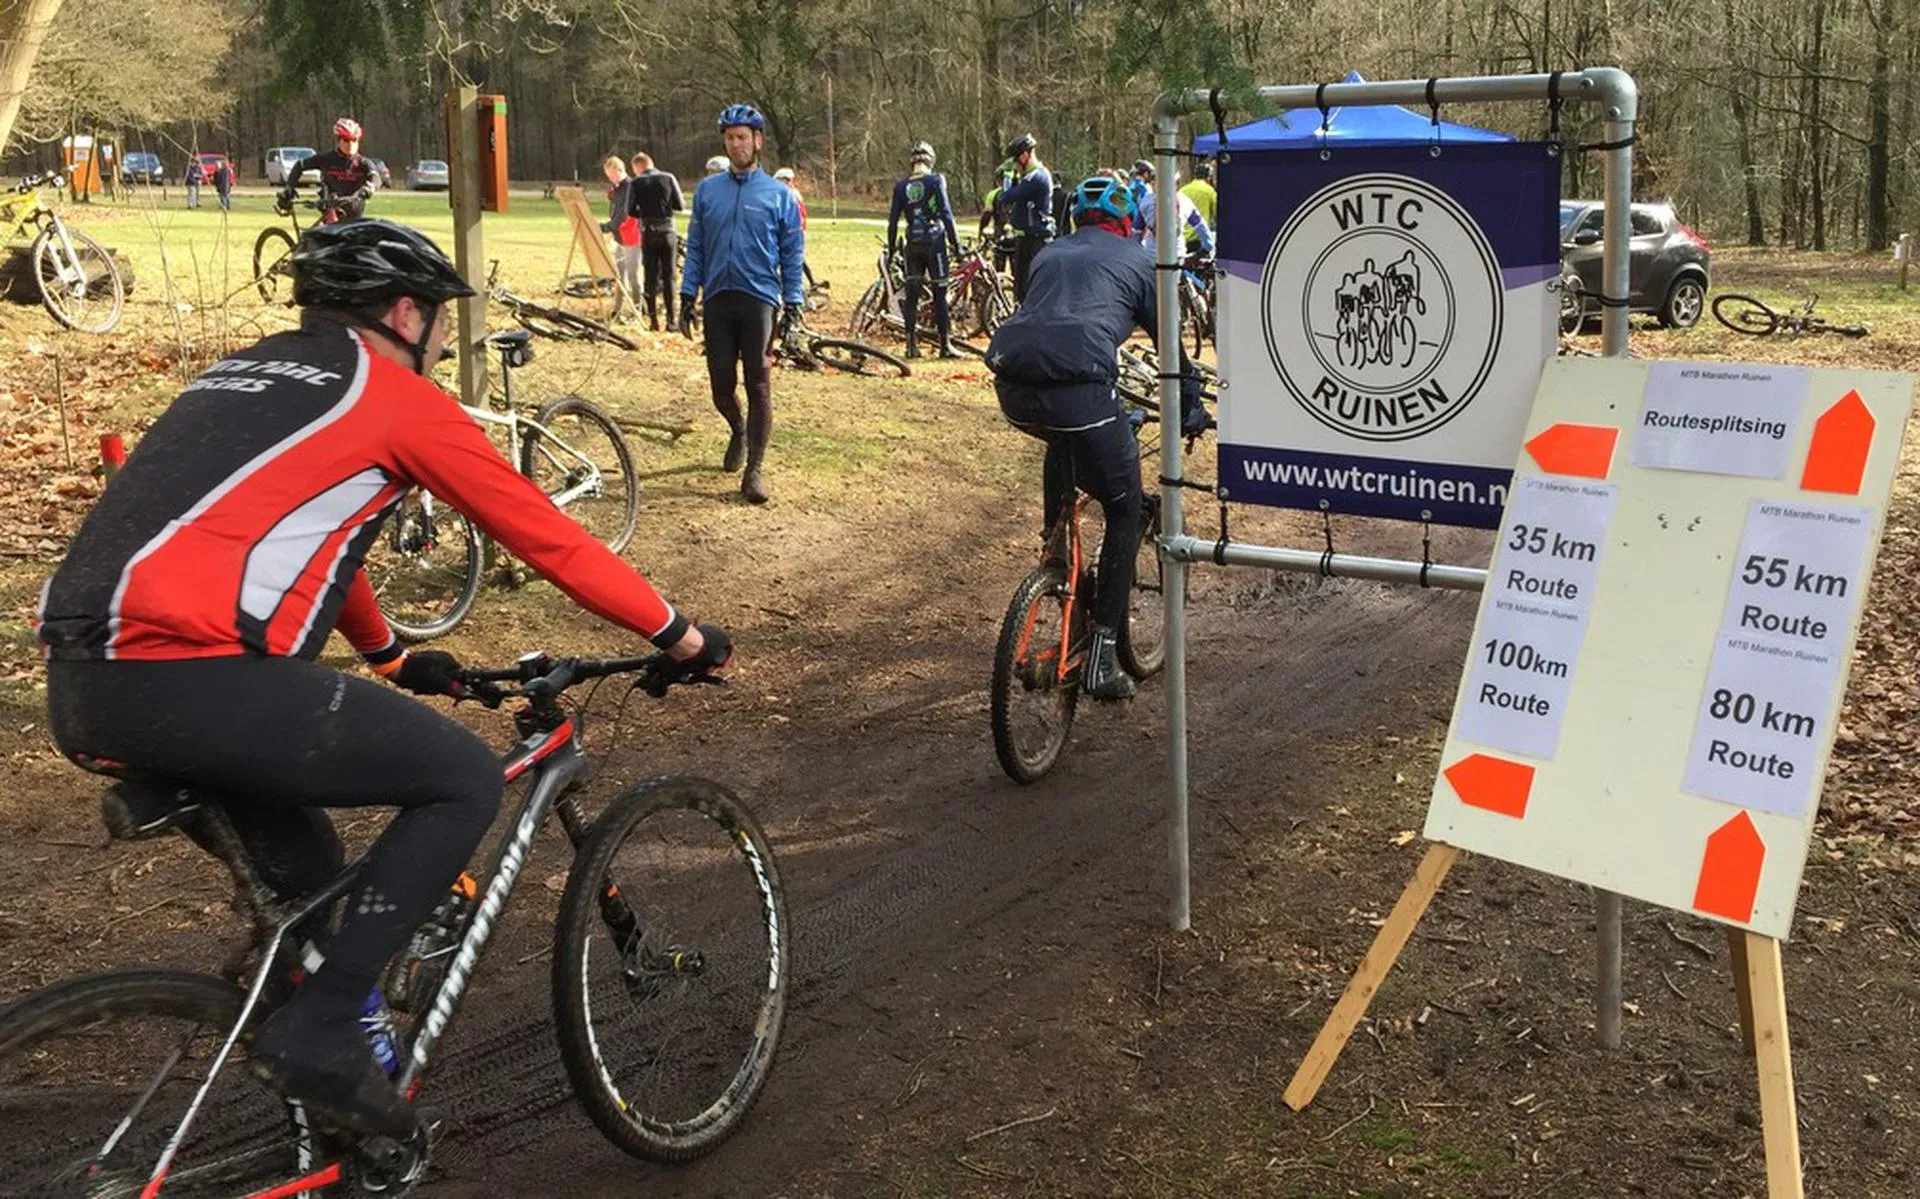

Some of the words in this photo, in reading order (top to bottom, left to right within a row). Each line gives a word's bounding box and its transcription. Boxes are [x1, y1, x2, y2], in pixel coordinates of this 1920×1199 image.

[1331, 194, 1423, 231] WTC
[1701, 370, 1740, 381] Marathon
[1742, 373, 1771, 382] Ruinen
[1312, 377, 1448, 427] RUINEN
[1645, 411, 1786, 439] Routesplitsing
[1783, 507, 1825, 522] Marathon
[1828, 513, 1861, 525] Ruinen
[1509, 525, 1545, 554] 35
[1553, 530, 1596, 561] km
[1506, 570, 1578, 599] Route
[1742, 555, 1788, 587] 55
[1795, 566, 1848, 598] km
[1740, 606, 1827, 639] Route
[1484, 639, 1567, 679] 100km
[1750, 642, 1792, 658] Marathon
[1795, 651, 1828, 664] Ruinen
[1479, 684, 1550, 716] Route
[1710, 689, 1755, 724] 80
[1762, 703, 1815, 738] km
[1708, 740, 1794, 779] Route
